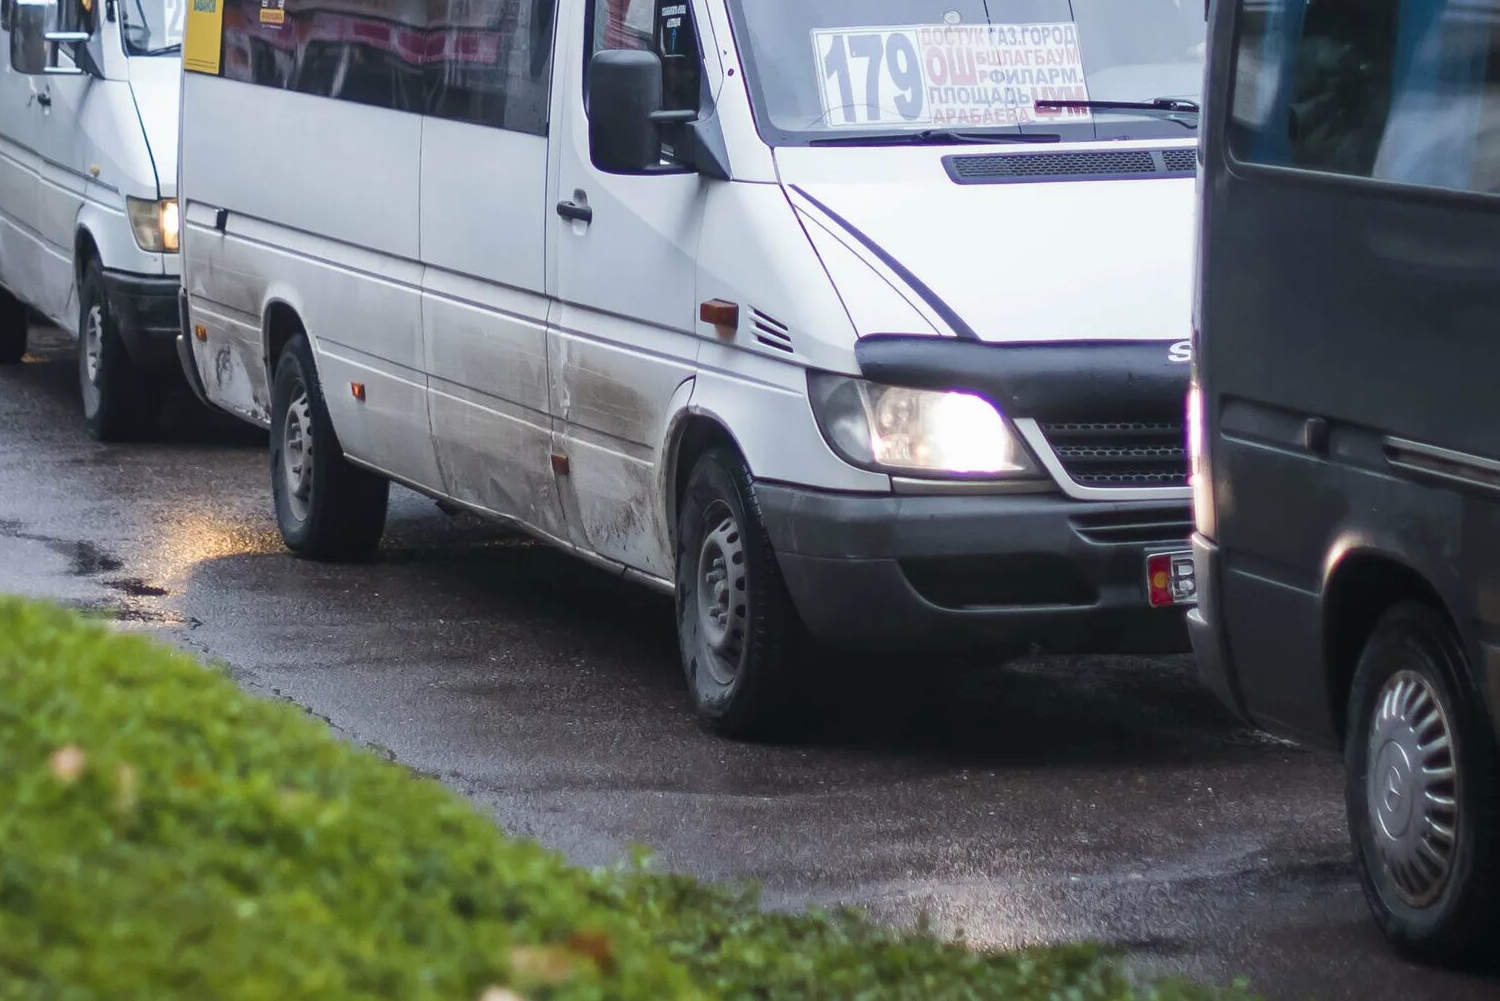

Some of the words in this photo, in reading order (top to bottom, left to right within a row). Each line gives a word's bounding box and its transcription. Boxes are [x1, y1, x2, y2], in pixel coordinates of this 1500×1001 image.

[921, 26, 983, 46] ДОСТУК
[824, 33, 923, 122] 179
[926, 47, 978, 86] ОШ
[929, 86, 1030, 107] ПЛОЩАДЬ
[1031, 85, 1088, 119] ЦУМ
[932, 106, 1030, 124] АРАБАЕВА
